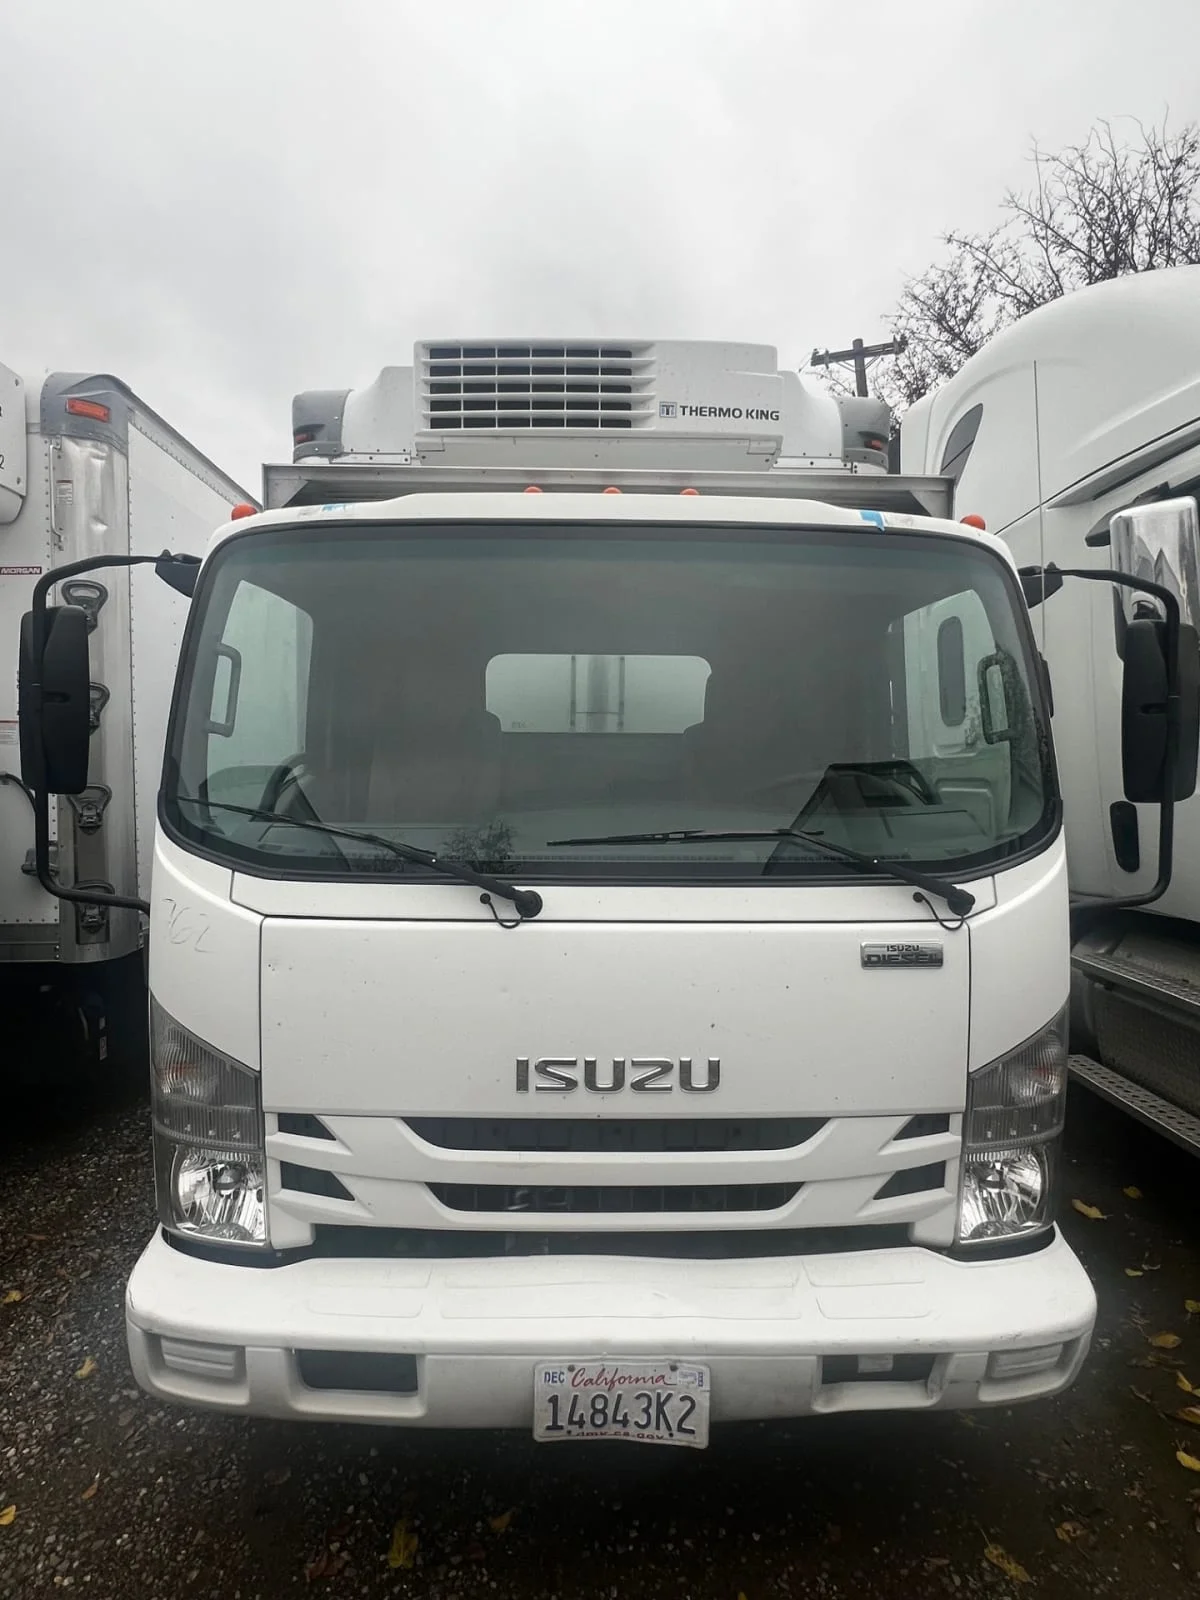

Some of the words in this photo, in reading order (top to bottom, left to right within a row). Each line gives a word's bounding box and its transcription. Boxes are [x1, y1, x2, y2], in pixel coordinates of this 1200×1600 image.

[680, 405, 742, 419] THERMO
[746, 408, 780, 421] KING
[886, 944, 920, 952] ISUZU
[865, 953, 940, 965] DIESEL
[516, 1057, 720, 1093] ISUZU
[544, 1371, 565, 1384] DEC
[571, 1367, 677, 1392] California
[545, 1391, 697, 1435] 14843K2
